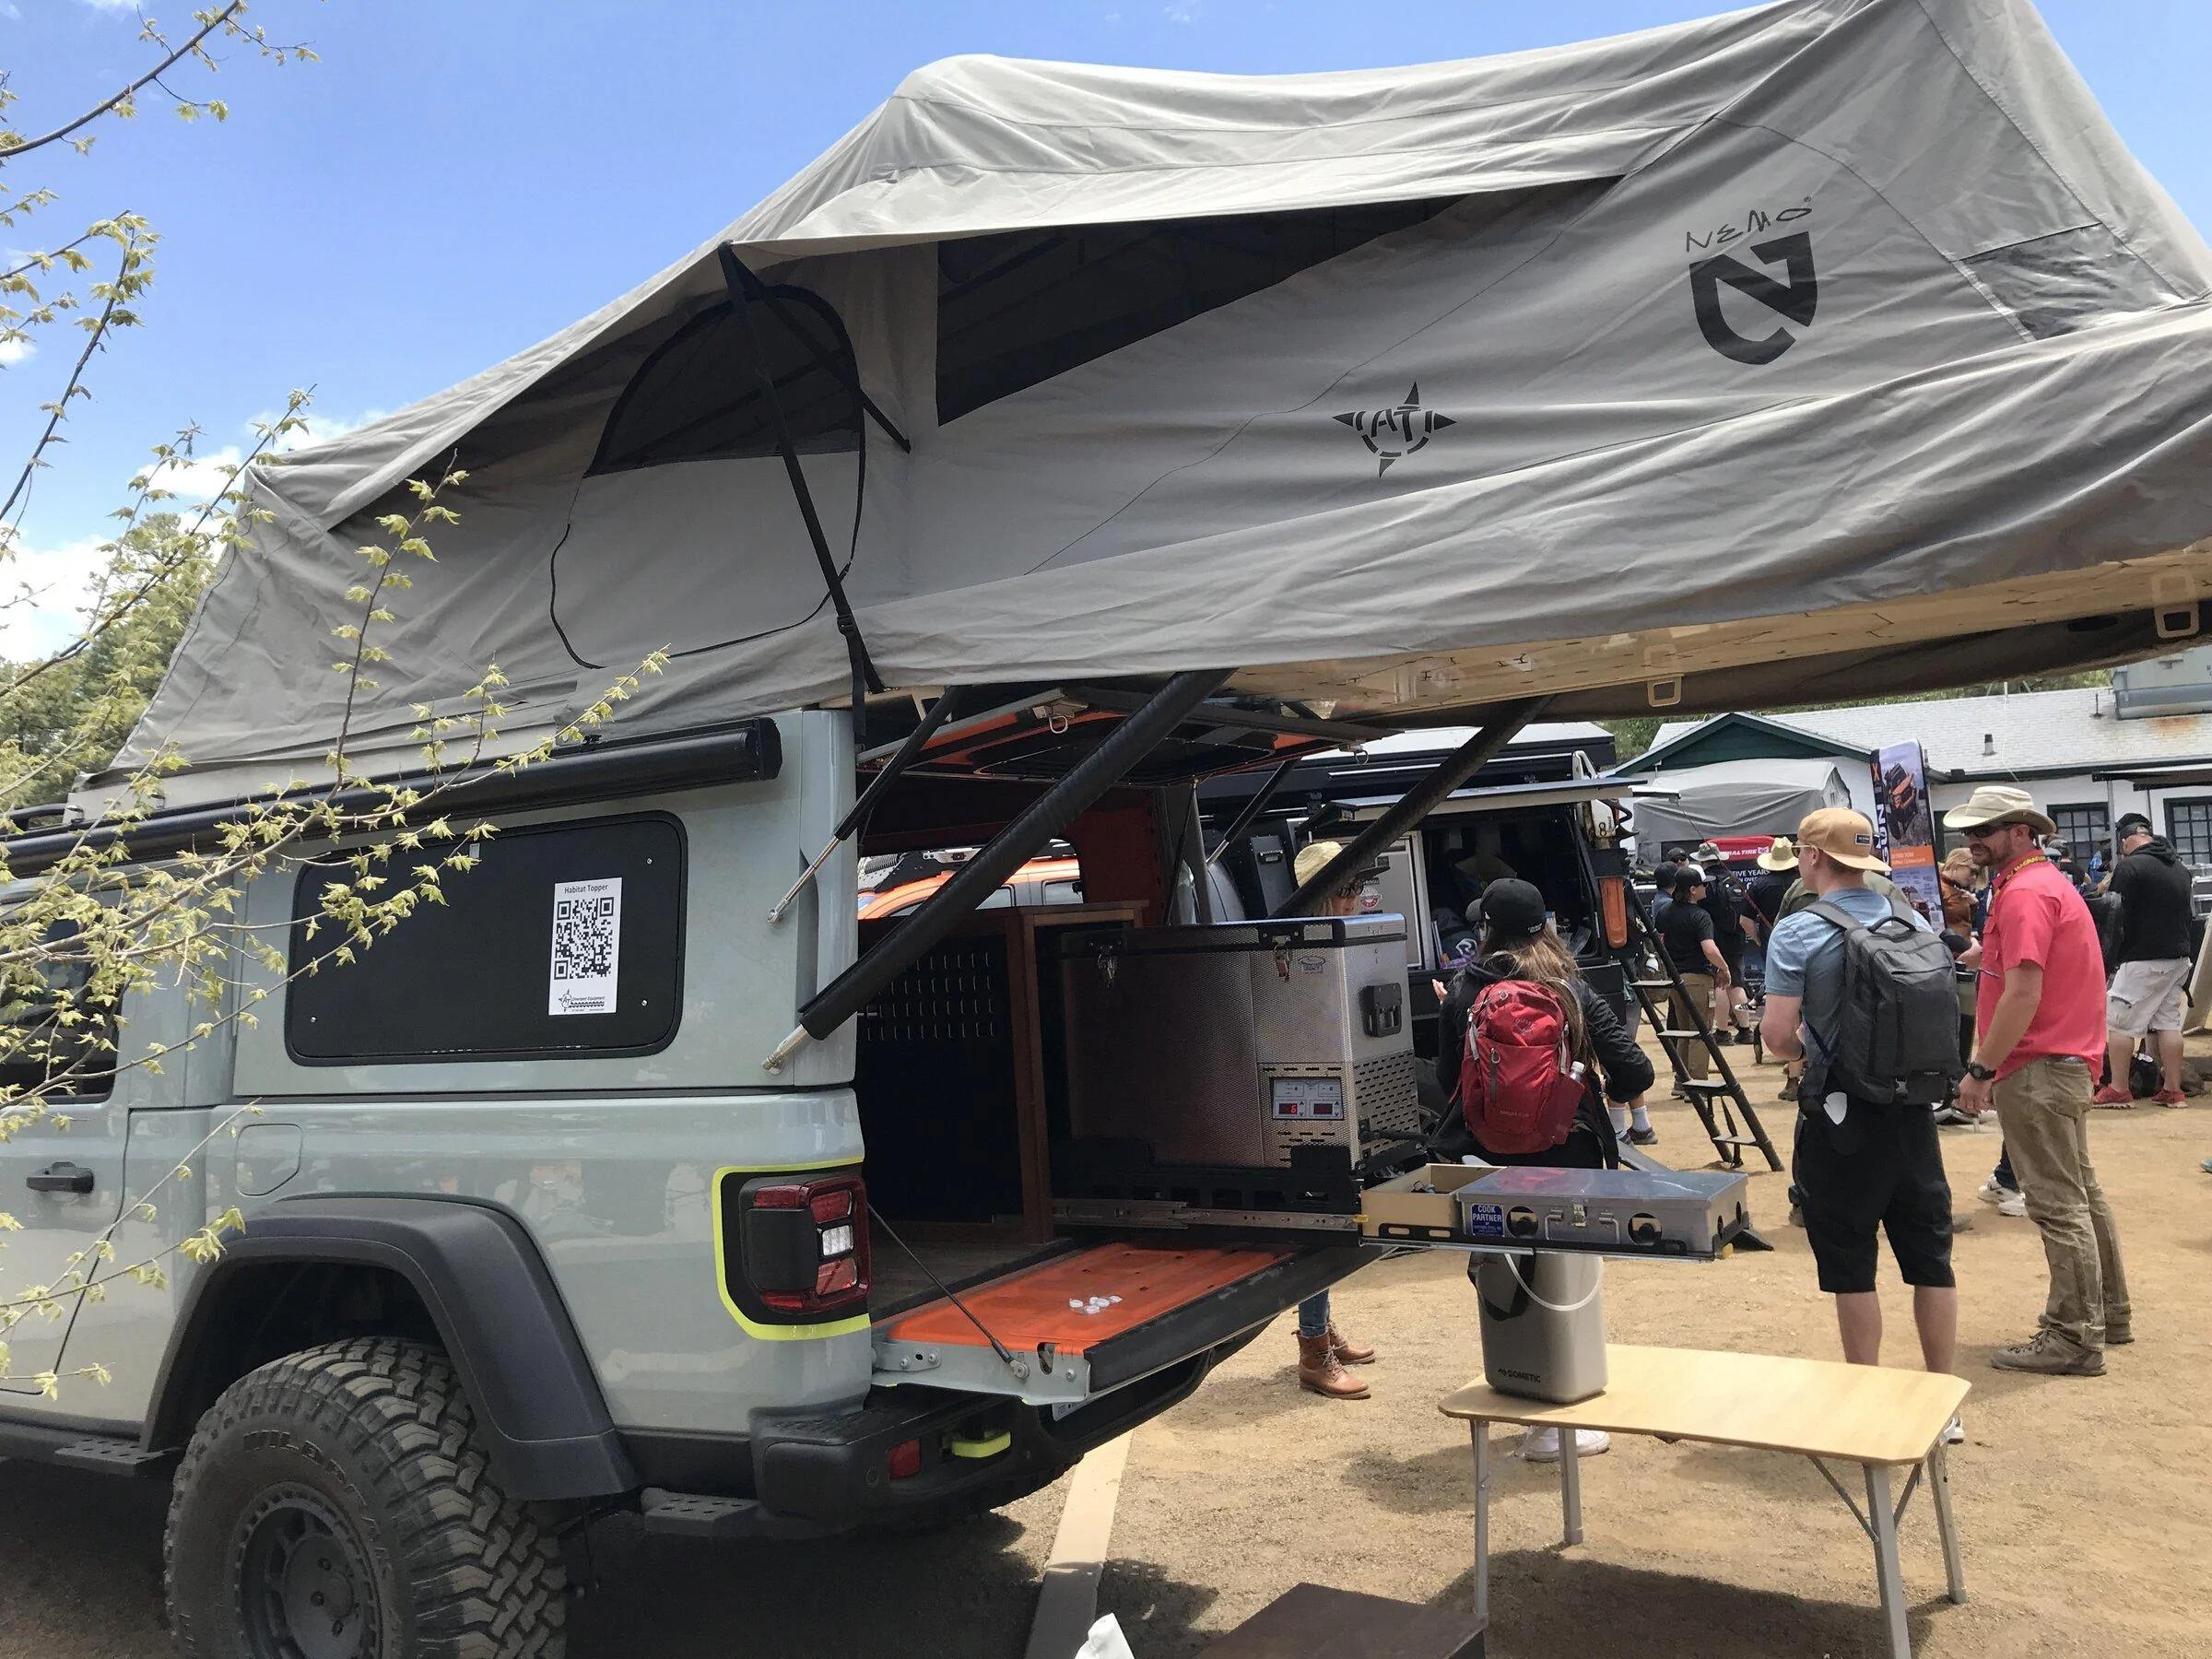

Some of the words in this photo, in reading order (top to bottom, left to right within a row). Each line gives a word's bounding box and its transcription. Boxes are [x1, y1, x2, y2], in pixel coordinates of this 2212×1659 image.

[1686, 207, 1812, 253] NEMO
[564, 886, 586, 894] Habitat
[587, 884, 608, 892] Topper
[1477, 1205, 1496, 1213] COOK
[1472, 1213, 1502, 1222] PARTNER
